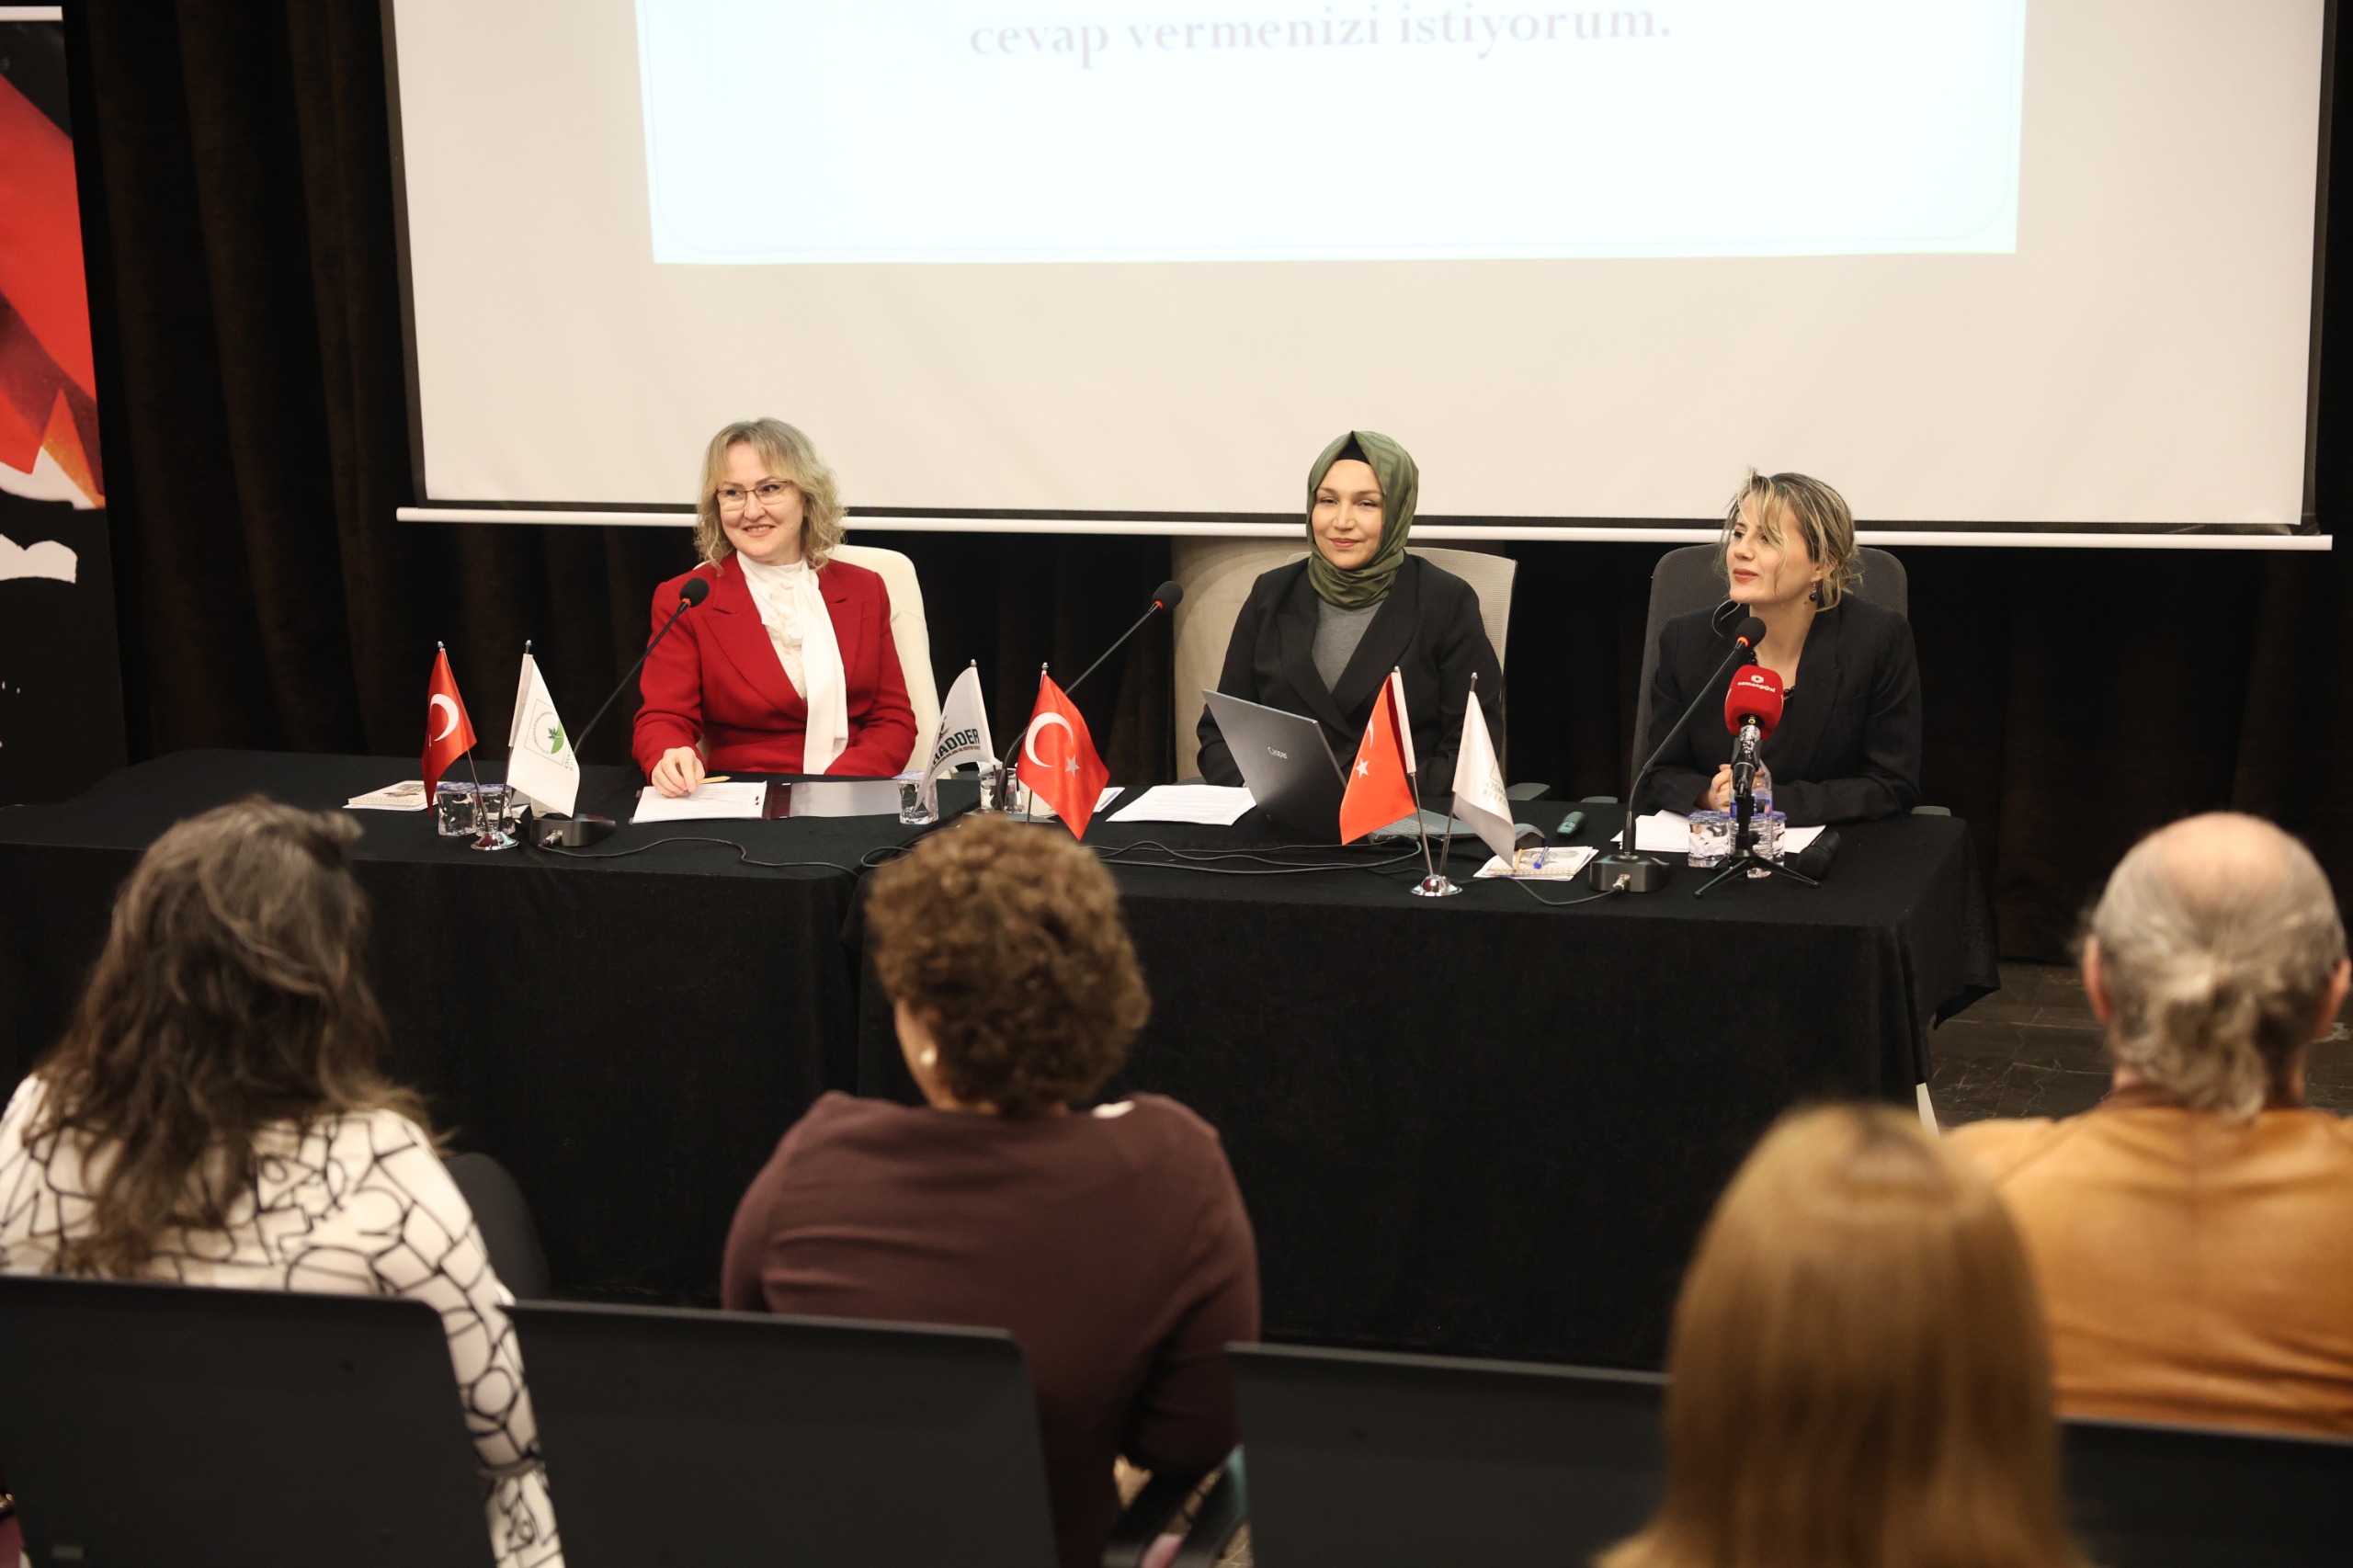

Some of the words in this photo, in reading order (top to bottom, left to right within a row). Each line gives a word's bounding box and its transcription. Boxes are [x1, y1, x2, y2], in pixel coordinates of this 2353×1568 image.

[969, 27, 1109, 71] cevap
[1127, 5, 1381, 52] vermenizi
[1400, 2, 1672, 62] istiyorum.
